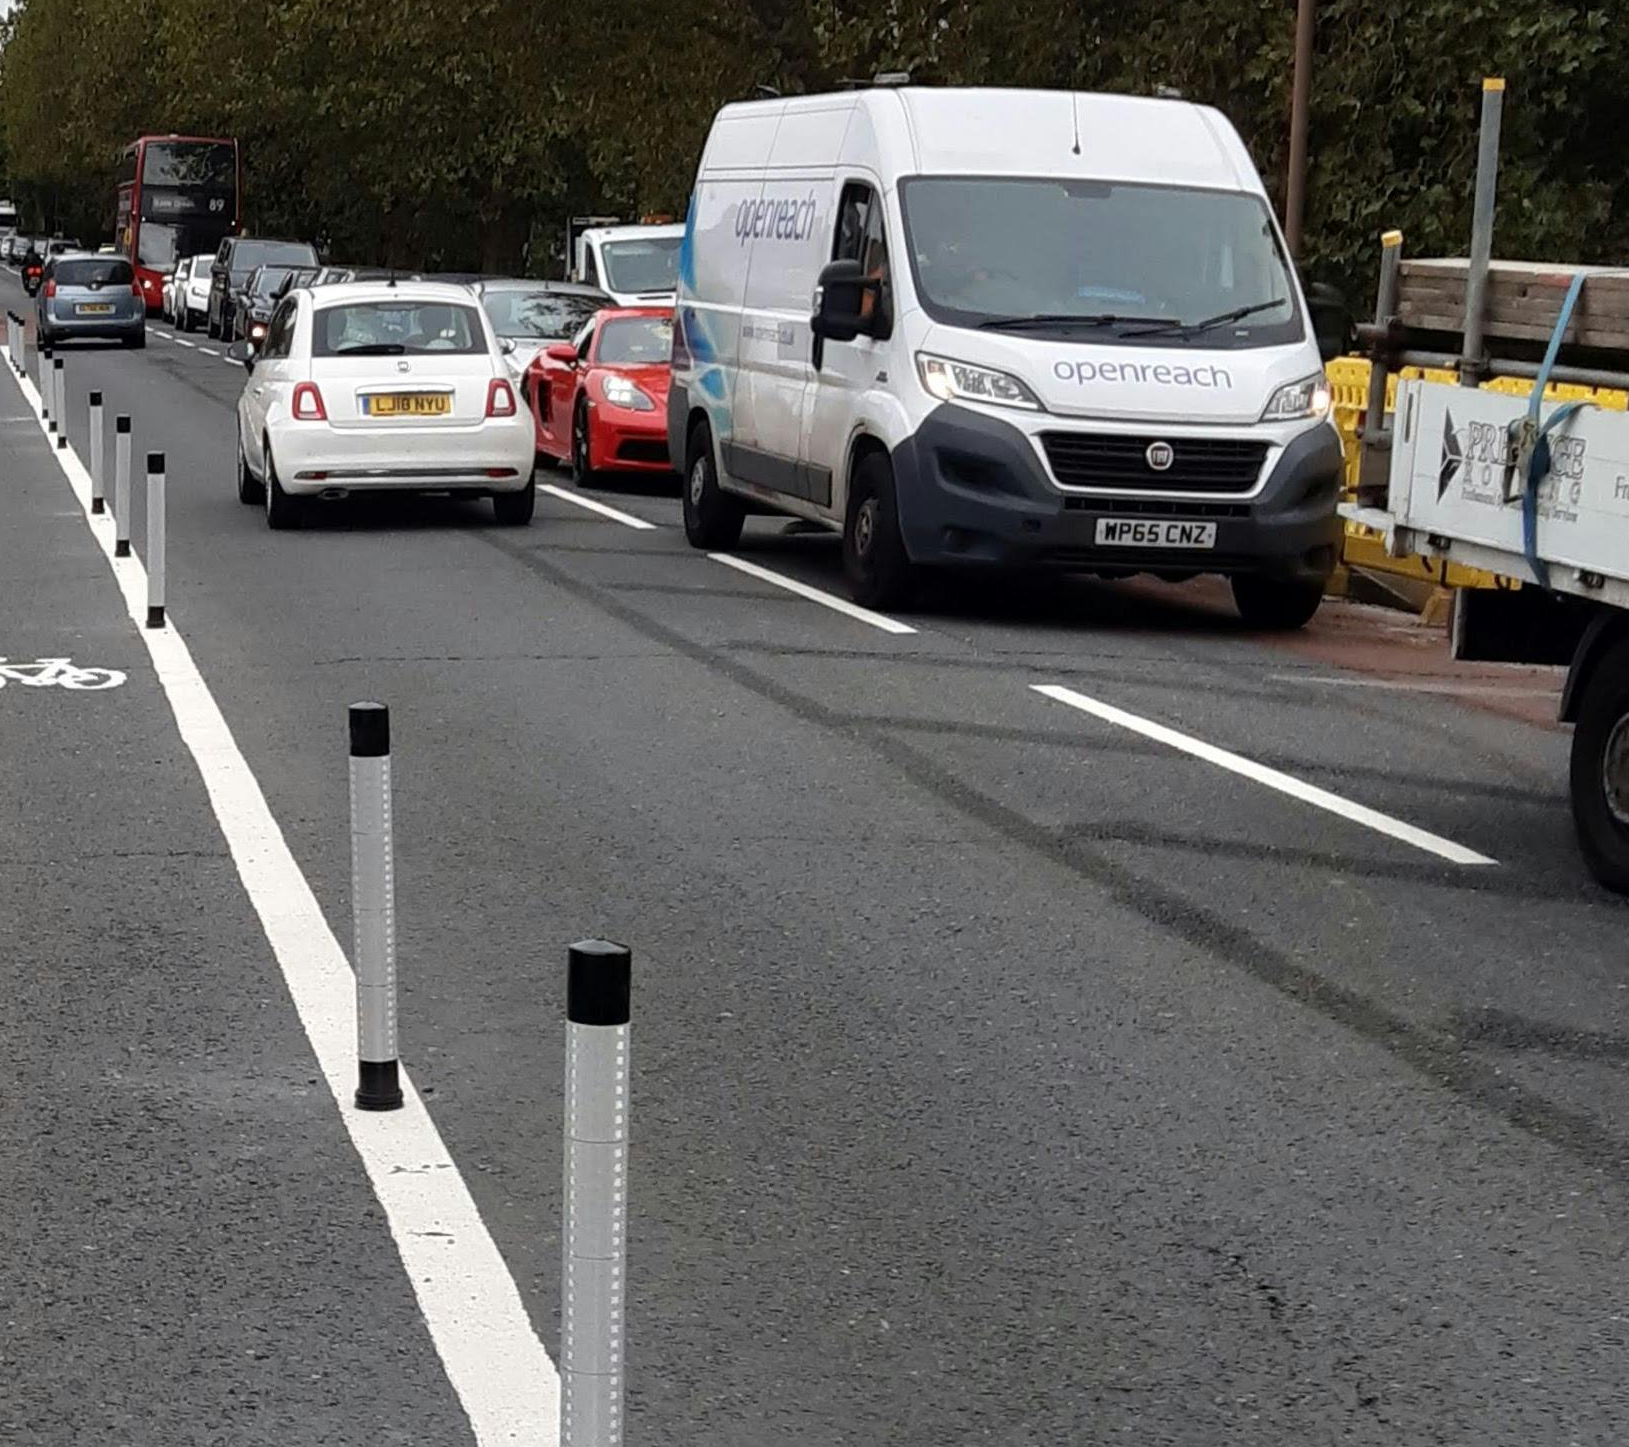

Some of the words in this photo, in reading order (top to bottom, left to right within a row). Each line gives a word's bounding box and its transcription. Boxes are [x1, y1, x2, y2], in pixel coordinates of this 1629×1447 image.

[209, 198, 225, 211] 89
[735, 189, 816, 248] openreach
[1053, 360, 1232, 389] openreach
[414, 396, 446, 412] NYU
[1104, 521, 1161, 544] WP65
[1164, 523, 1207, 545] CNZ
